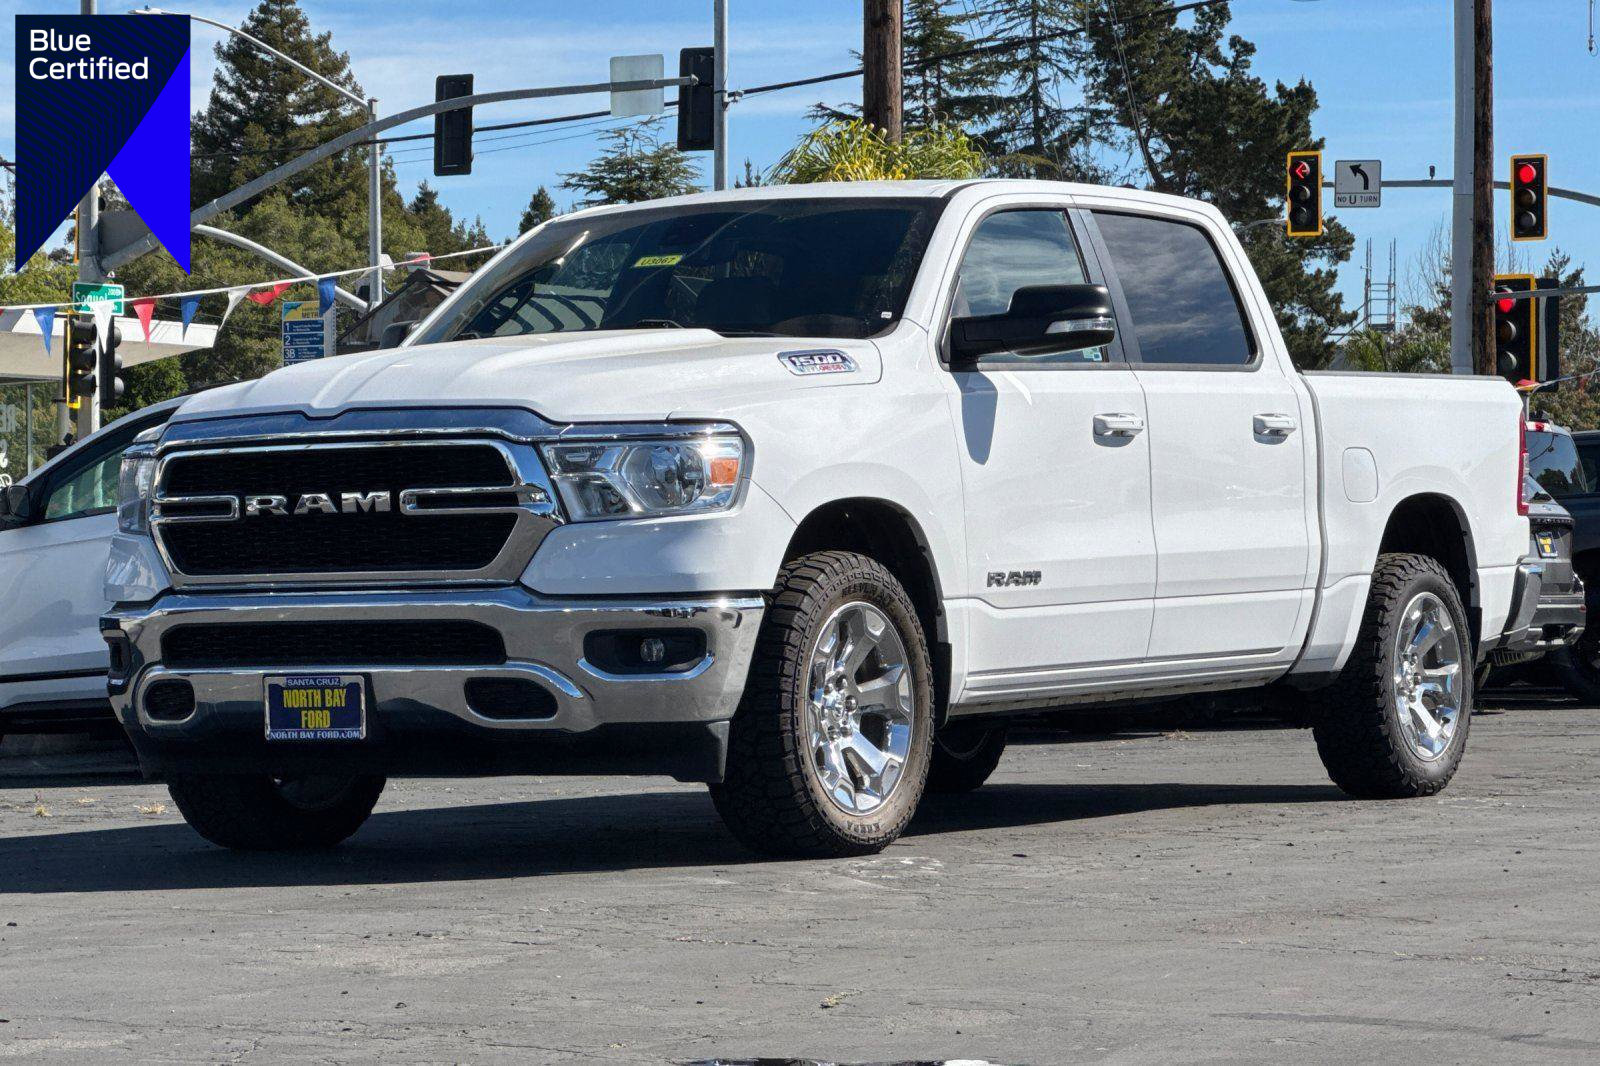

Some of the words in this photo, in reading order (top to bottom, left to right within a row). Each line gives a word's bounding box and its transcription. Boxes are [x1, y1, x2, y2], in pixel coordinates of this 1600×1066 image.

[1349, 195, 1357, 204] U
[285, 322, 290, 332] 1
[284, 335, 291, 346] 2
[284, 348, 296, 359] 3B
[789, 353, 843, 366] 1500
[245, 491, 391, 516] RAM
[986, 570, 1042, 588] RAM
[316, 678, 341, 686] CRUZ
[283, 689, 321, 708] NORTH
[324, 688, 347, 707] BAY
[301, 710, 331, 728] FORD
[270, 731, 298, 739] NORTH
[300, 731, 315, 739] BAY
